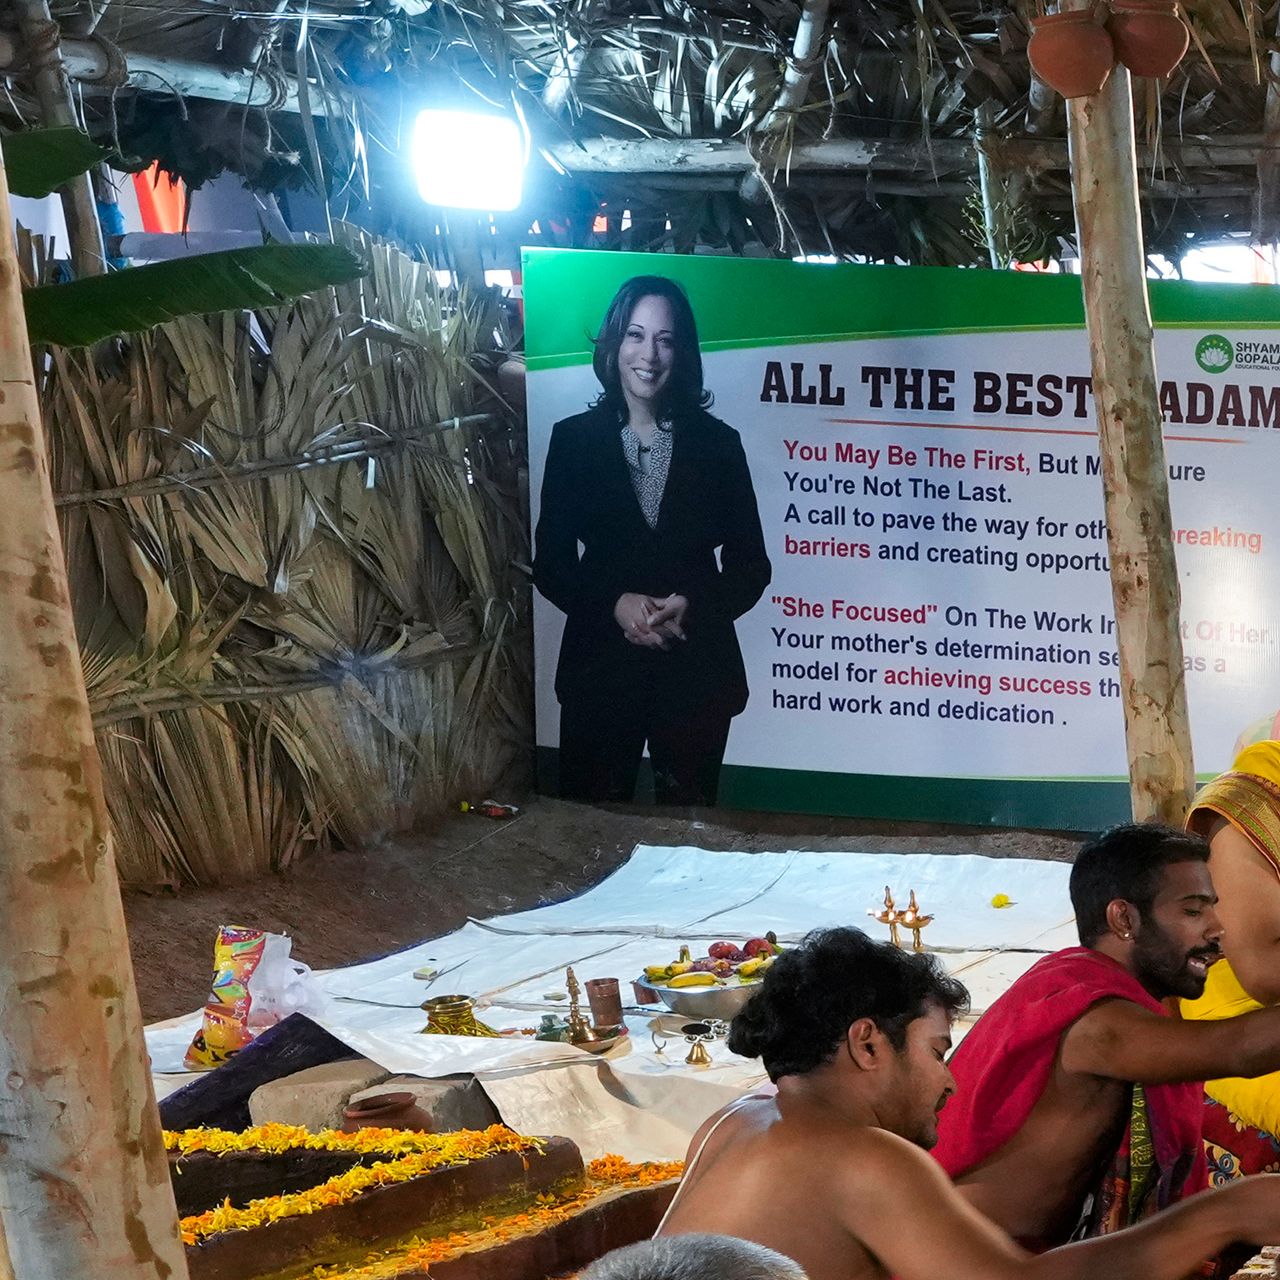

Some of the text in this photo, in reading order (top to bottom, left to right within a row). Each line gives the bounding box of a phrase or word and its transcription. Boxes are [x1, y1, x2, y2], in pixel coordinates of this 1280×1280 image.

[760, 362, 844, 406] ALL
[862, 366, 955, 411] THE
[973, 371, 1093, 418] BEST
[783, 440, 826, 461] You
[836, 443, 880, 469] May
[889, 446, 916, 466] Be
[924, 447, 965, 468] The
[975, 450, 1030, 475] First,
[1040, 453, 1078, 474] But
[1170, 465, 1205, 481] ure
[784, 472, 1011, 502] You're Not The Last.
[784, 504, 800, 523] A
[808, 506, 845, 525] call
[853, 508, 874, 527] to
[883, 514, 935, 532] pave
[942, 512, 977, 532] the
[985, 519, 1029, 540] way
[1036, 517, 1068, 537] for
[786, 535, 1017, 571] barriers and creating
[772, 596, 824, 618] "She
[833, 600, 937, 623] Focused"
[946, 606, 976, 626] On
[985, 608, 1026, 629] The
[1034, 611, 1092, 633] Work
[771, 627, 824, 648] Your
[832, 634, 927, 655] mother's
[935, 637, 1090, 664] determination
[773, 661, 838, 680] model
[846, 663, 877, 683] for
[885, 667, 991, 695] achieving
[1000, 677, 1091, 695] success
[773, 689, 1053, 724] hard work and dedication
